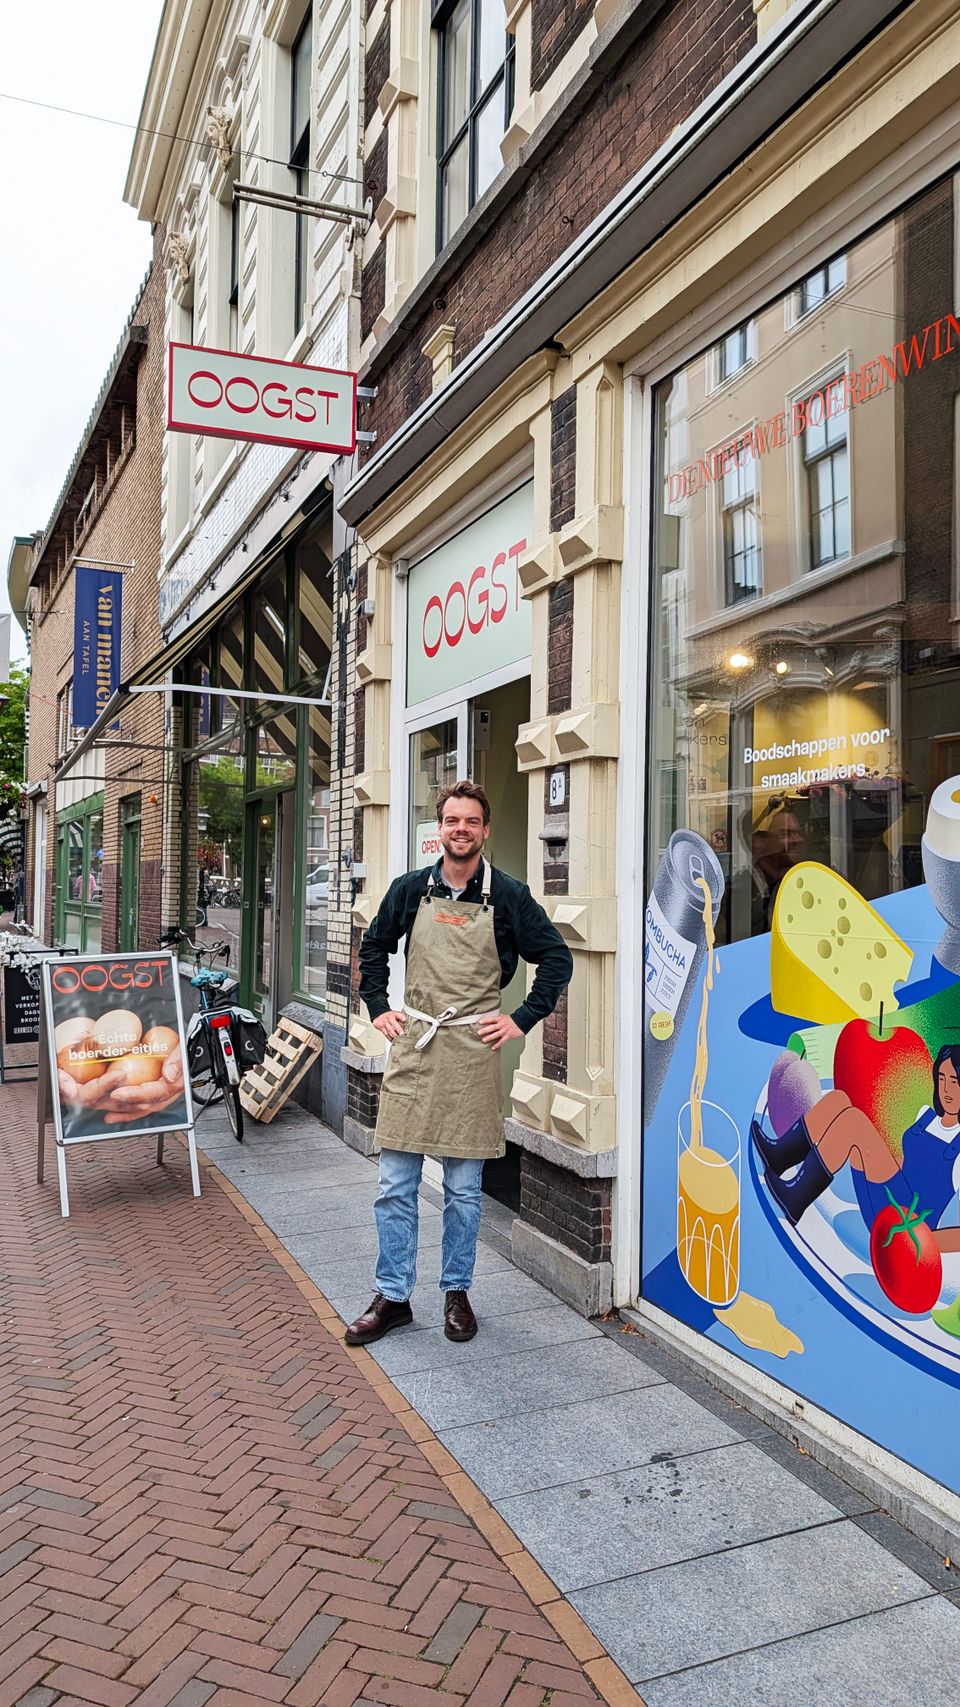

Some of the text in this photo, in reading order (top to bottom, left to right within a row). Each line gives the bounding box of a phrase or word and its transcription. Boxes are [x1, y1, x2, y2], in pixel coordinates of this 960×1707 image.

[187, 370, 339, 426] OOGST
[668, 464, 698, 505] DE
[696, 411, 787, 490] NIEUWE
[97, 584, 113, 627] van
[422, 538, 527, 658] OOGST
[81, 620, 90, 675] AAN TAFEL
[743, 727, 890, 764] Boodschappen voor
[760, 762, 866, 789] smaakmakers
[52, 960, 168, 994] OOGST
[98, 1031, 137, 1045] Echte
